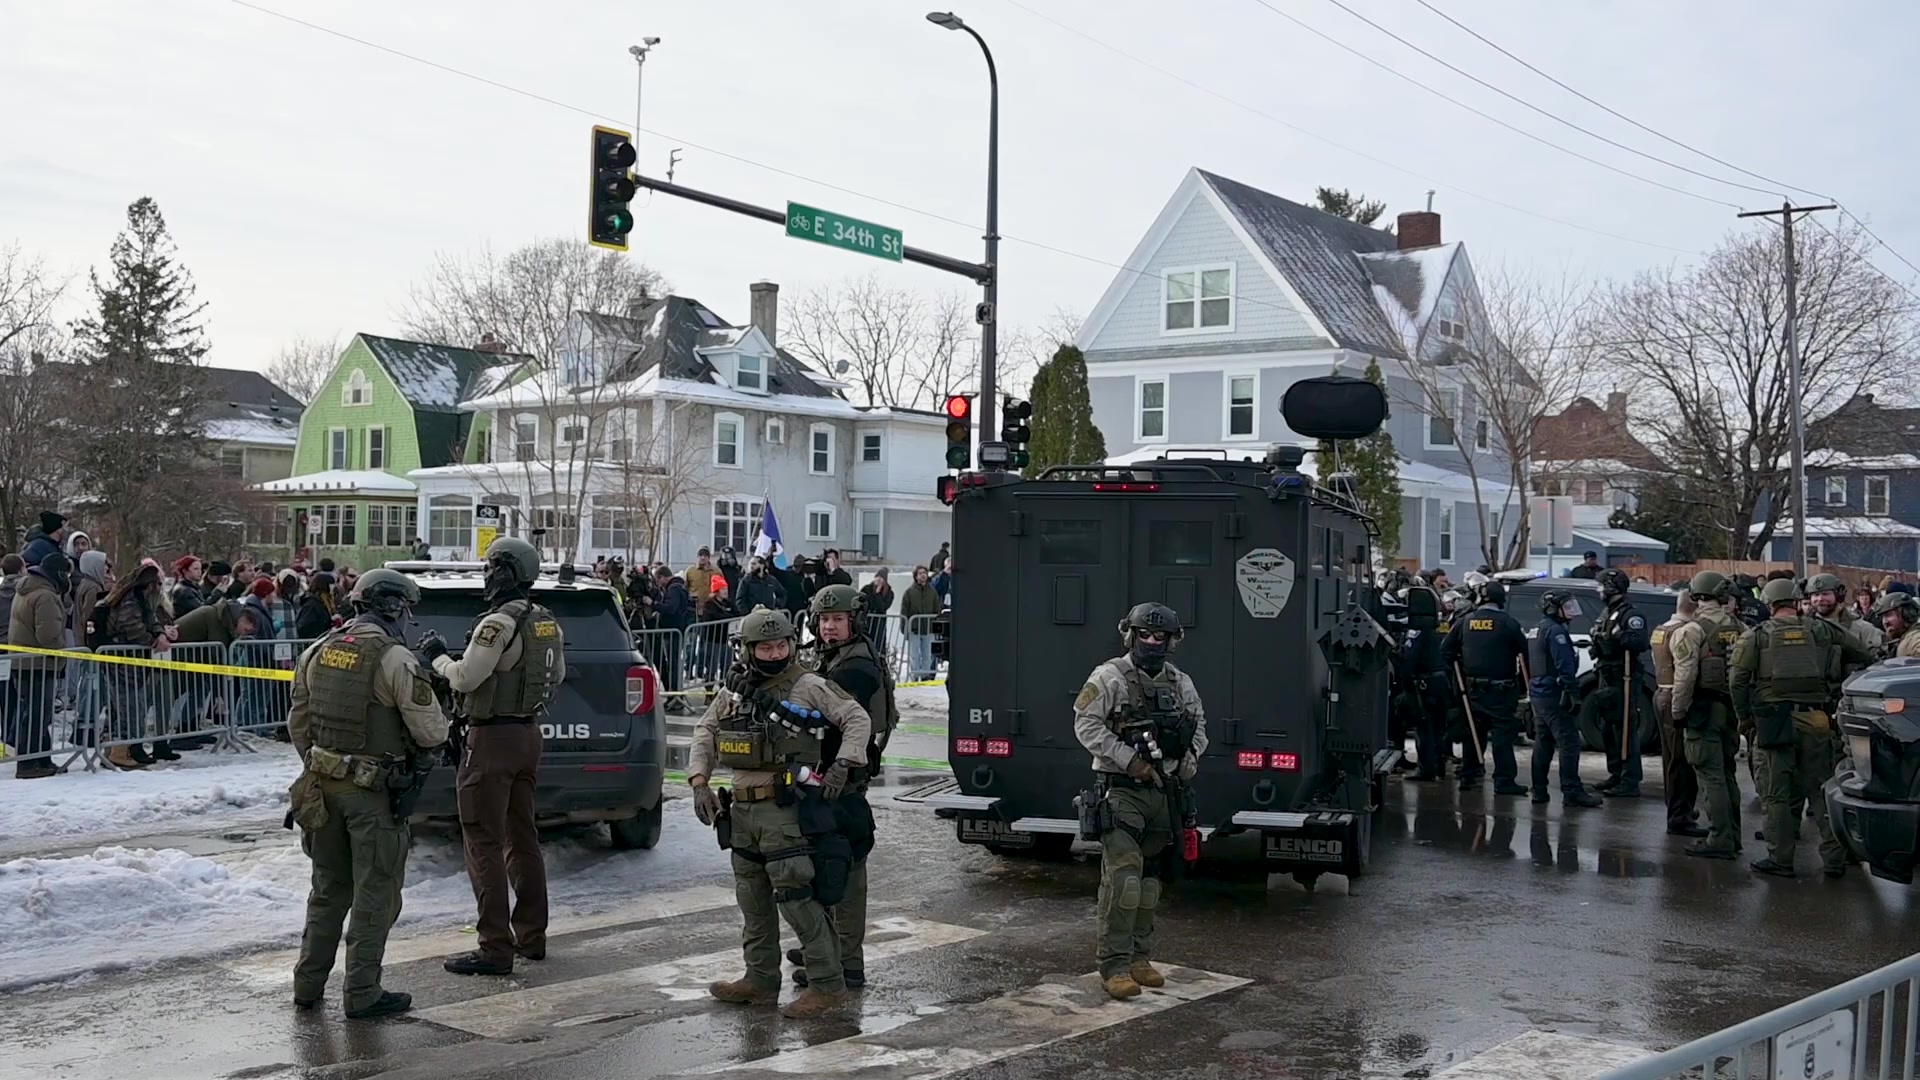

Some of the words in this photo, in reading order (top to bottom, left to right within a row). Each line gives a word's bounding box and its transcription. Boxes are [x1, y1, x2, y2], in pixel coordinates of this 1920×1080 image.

[814, 216, 825, 236] E
[832, 221, 875, 249] 34th
[882, 234, 899, 255] St
[1469, 620, 1493, 630] POLICE
[320, 646, 359, 670] SHERIFF
[969, 708, 993, 724] B1
[720, 741, 751, 754] POLICE
[1266, 837, 1342, 855] LENCO
